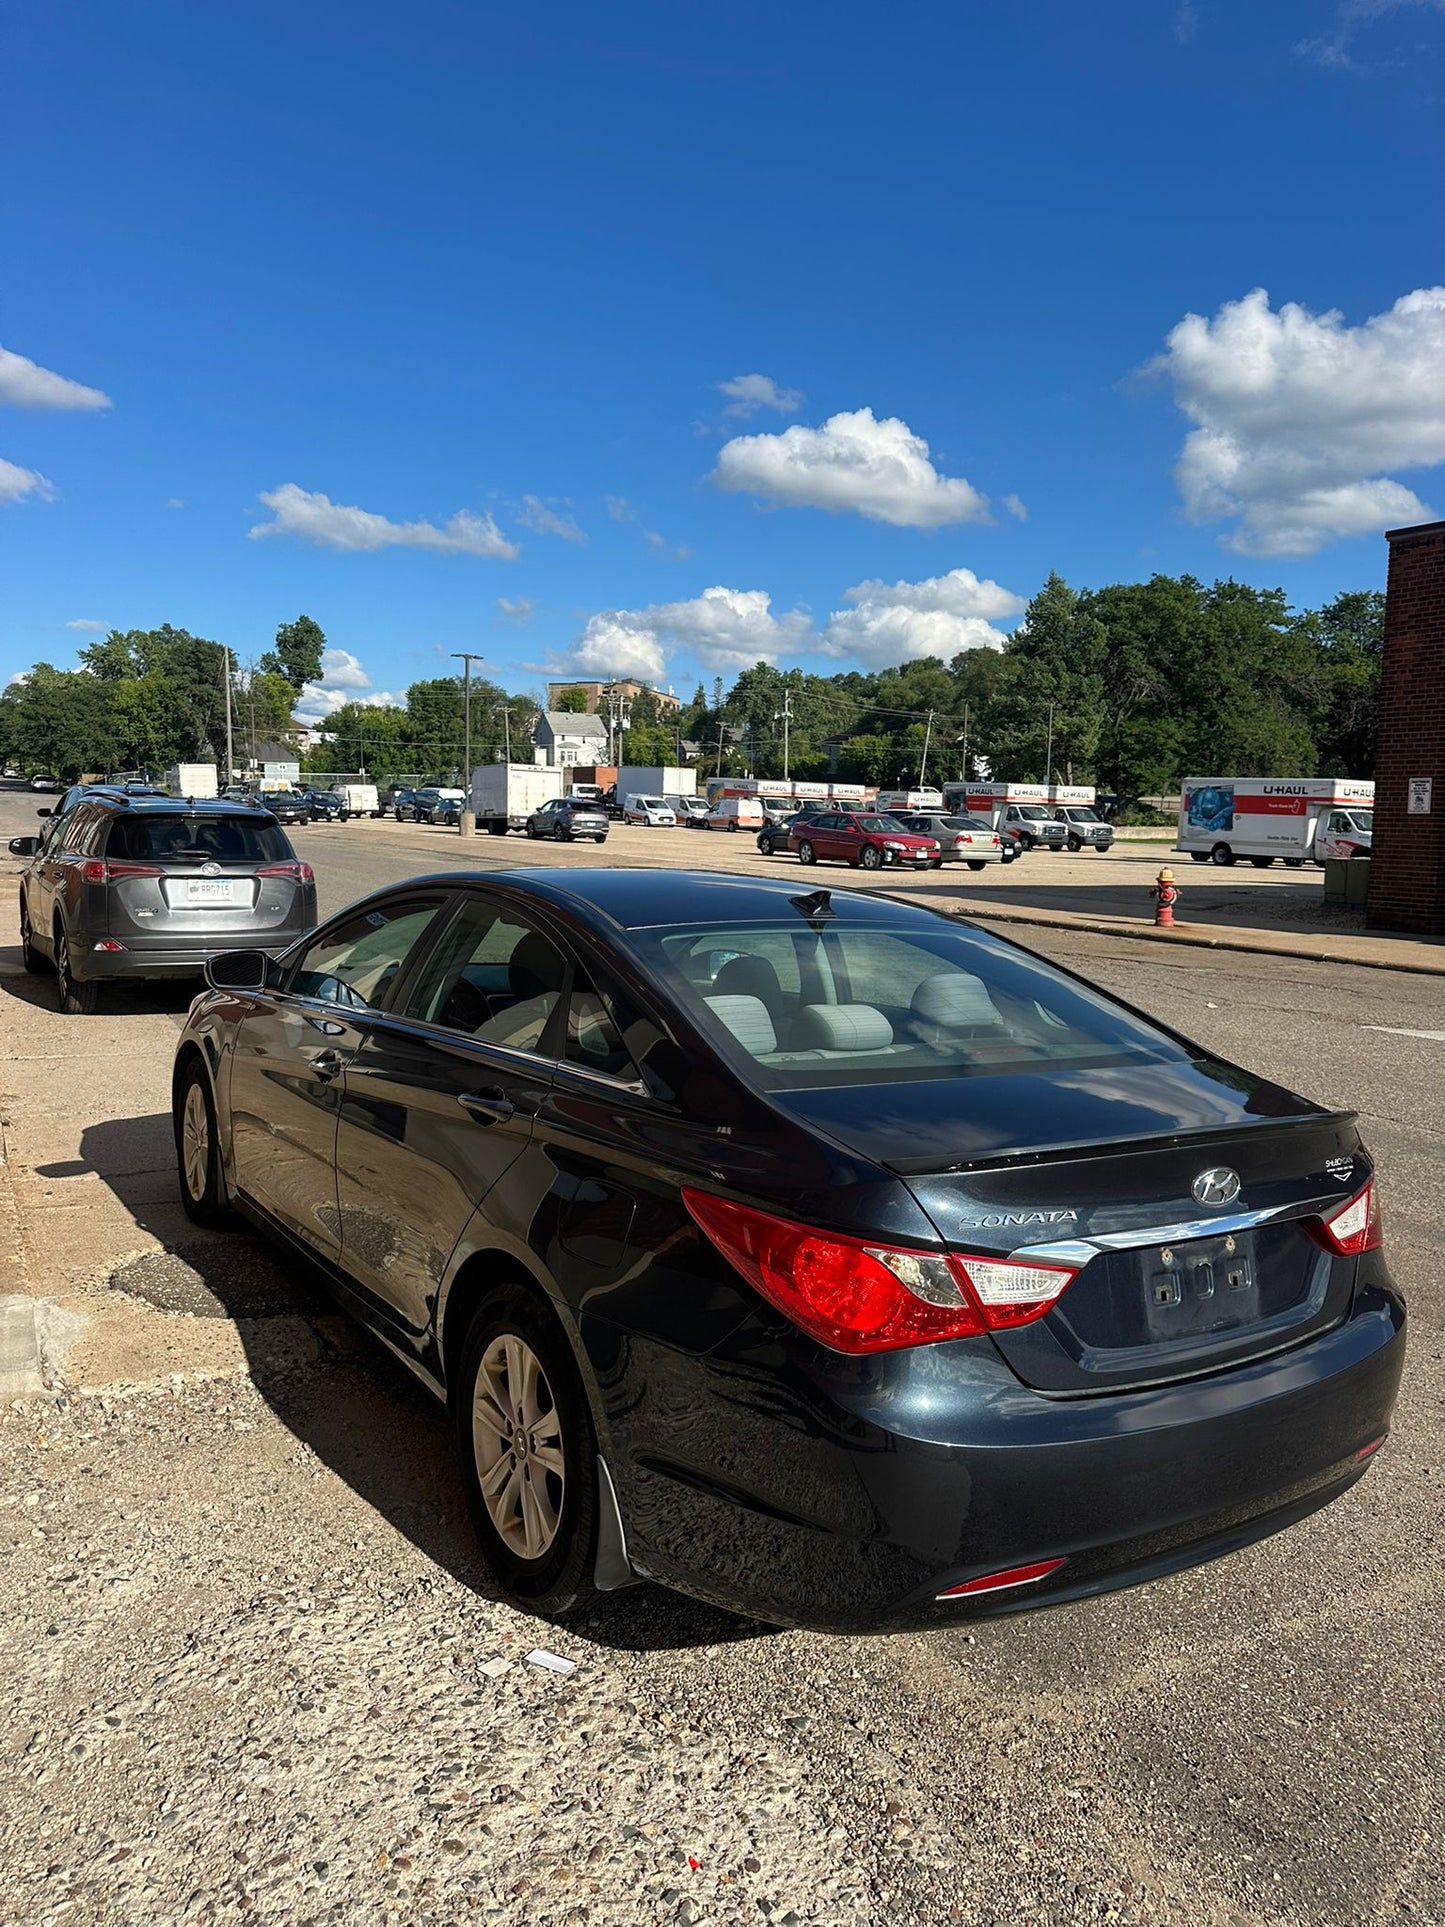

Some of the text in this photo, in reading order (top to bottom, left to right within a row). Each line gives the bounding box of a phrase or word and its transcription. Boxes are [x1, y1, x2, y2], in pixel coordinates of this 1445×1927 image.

[837, 788, 862, 796] U-HAUL
[968, 787, 994, 795] U-HAUL
[1014, 789, 1043, 797] U-HAUL
[1062, 790, 1091, 798] U-HAUL
[1263, 785, 1308, 795] U-HAUL
[958, 1209, 1078, 1232] SONATA
